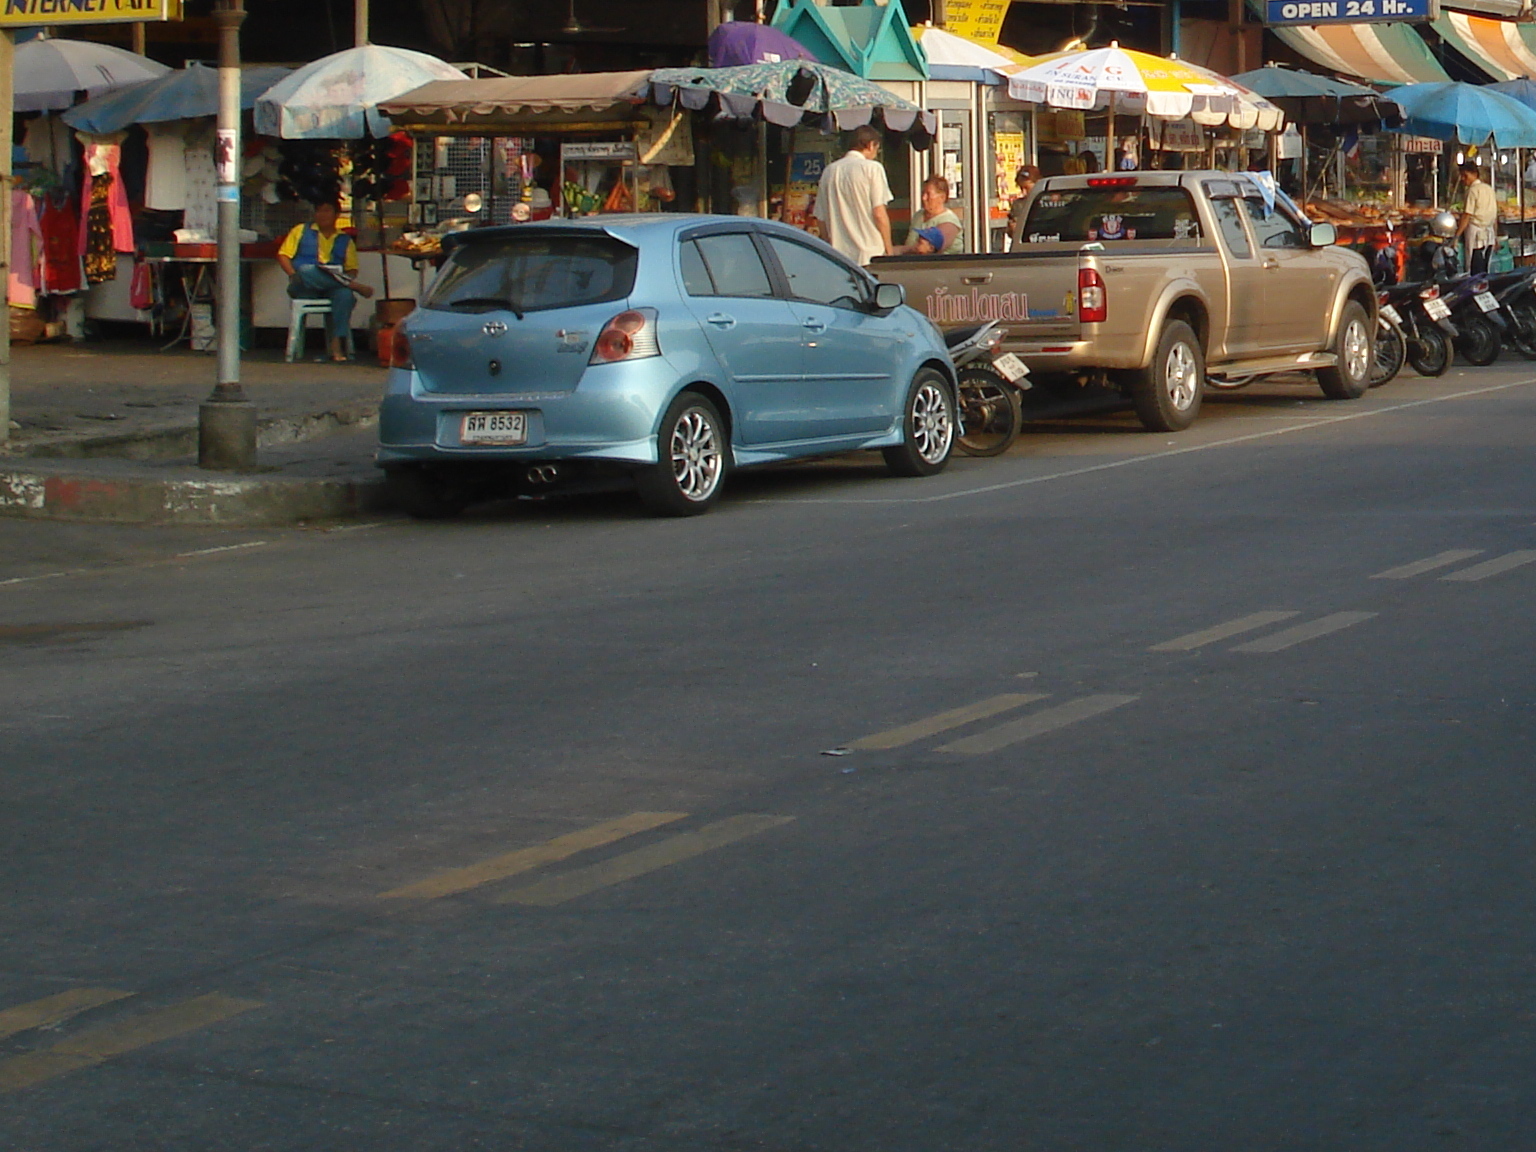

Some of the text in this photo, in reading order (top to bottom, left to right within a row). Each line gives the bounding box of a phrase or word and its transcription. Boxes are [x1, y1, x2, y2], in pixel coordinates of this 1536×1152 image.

[1281, 0, 1414, 19] OPEN 24 Hr.
[1050, 88, 1074, 100] ING
[490, 416, 521, 431] 8532
